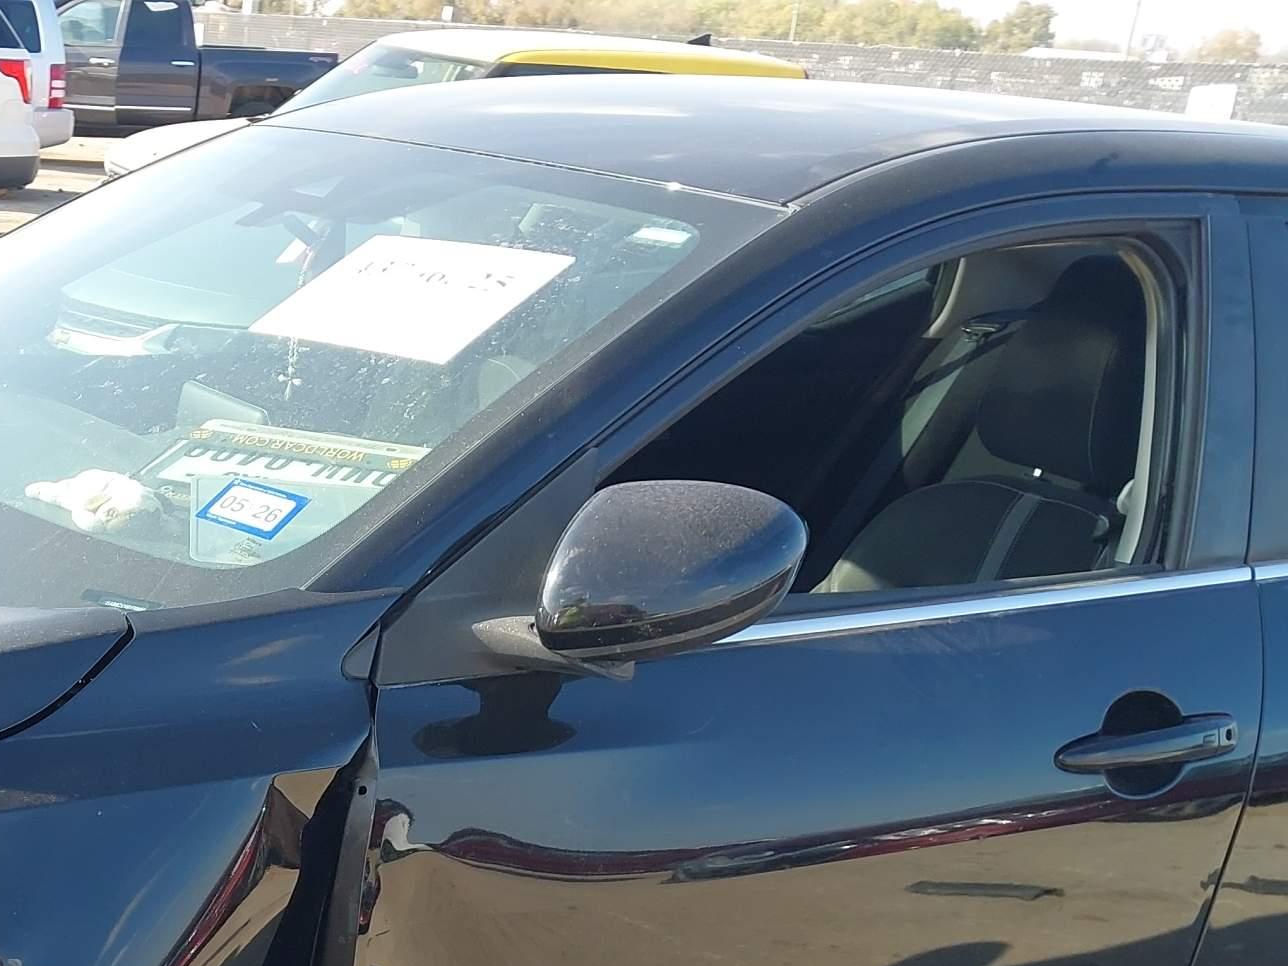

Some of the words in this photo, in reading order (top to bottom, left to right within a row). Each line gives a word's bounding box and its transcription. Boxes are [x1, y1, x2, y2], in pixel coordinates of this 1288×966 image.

[231, 433, 367, 462] WORLDCAR.COM
[219, 494, 247, 513] 05
[251, 503, 283, 524] 26
